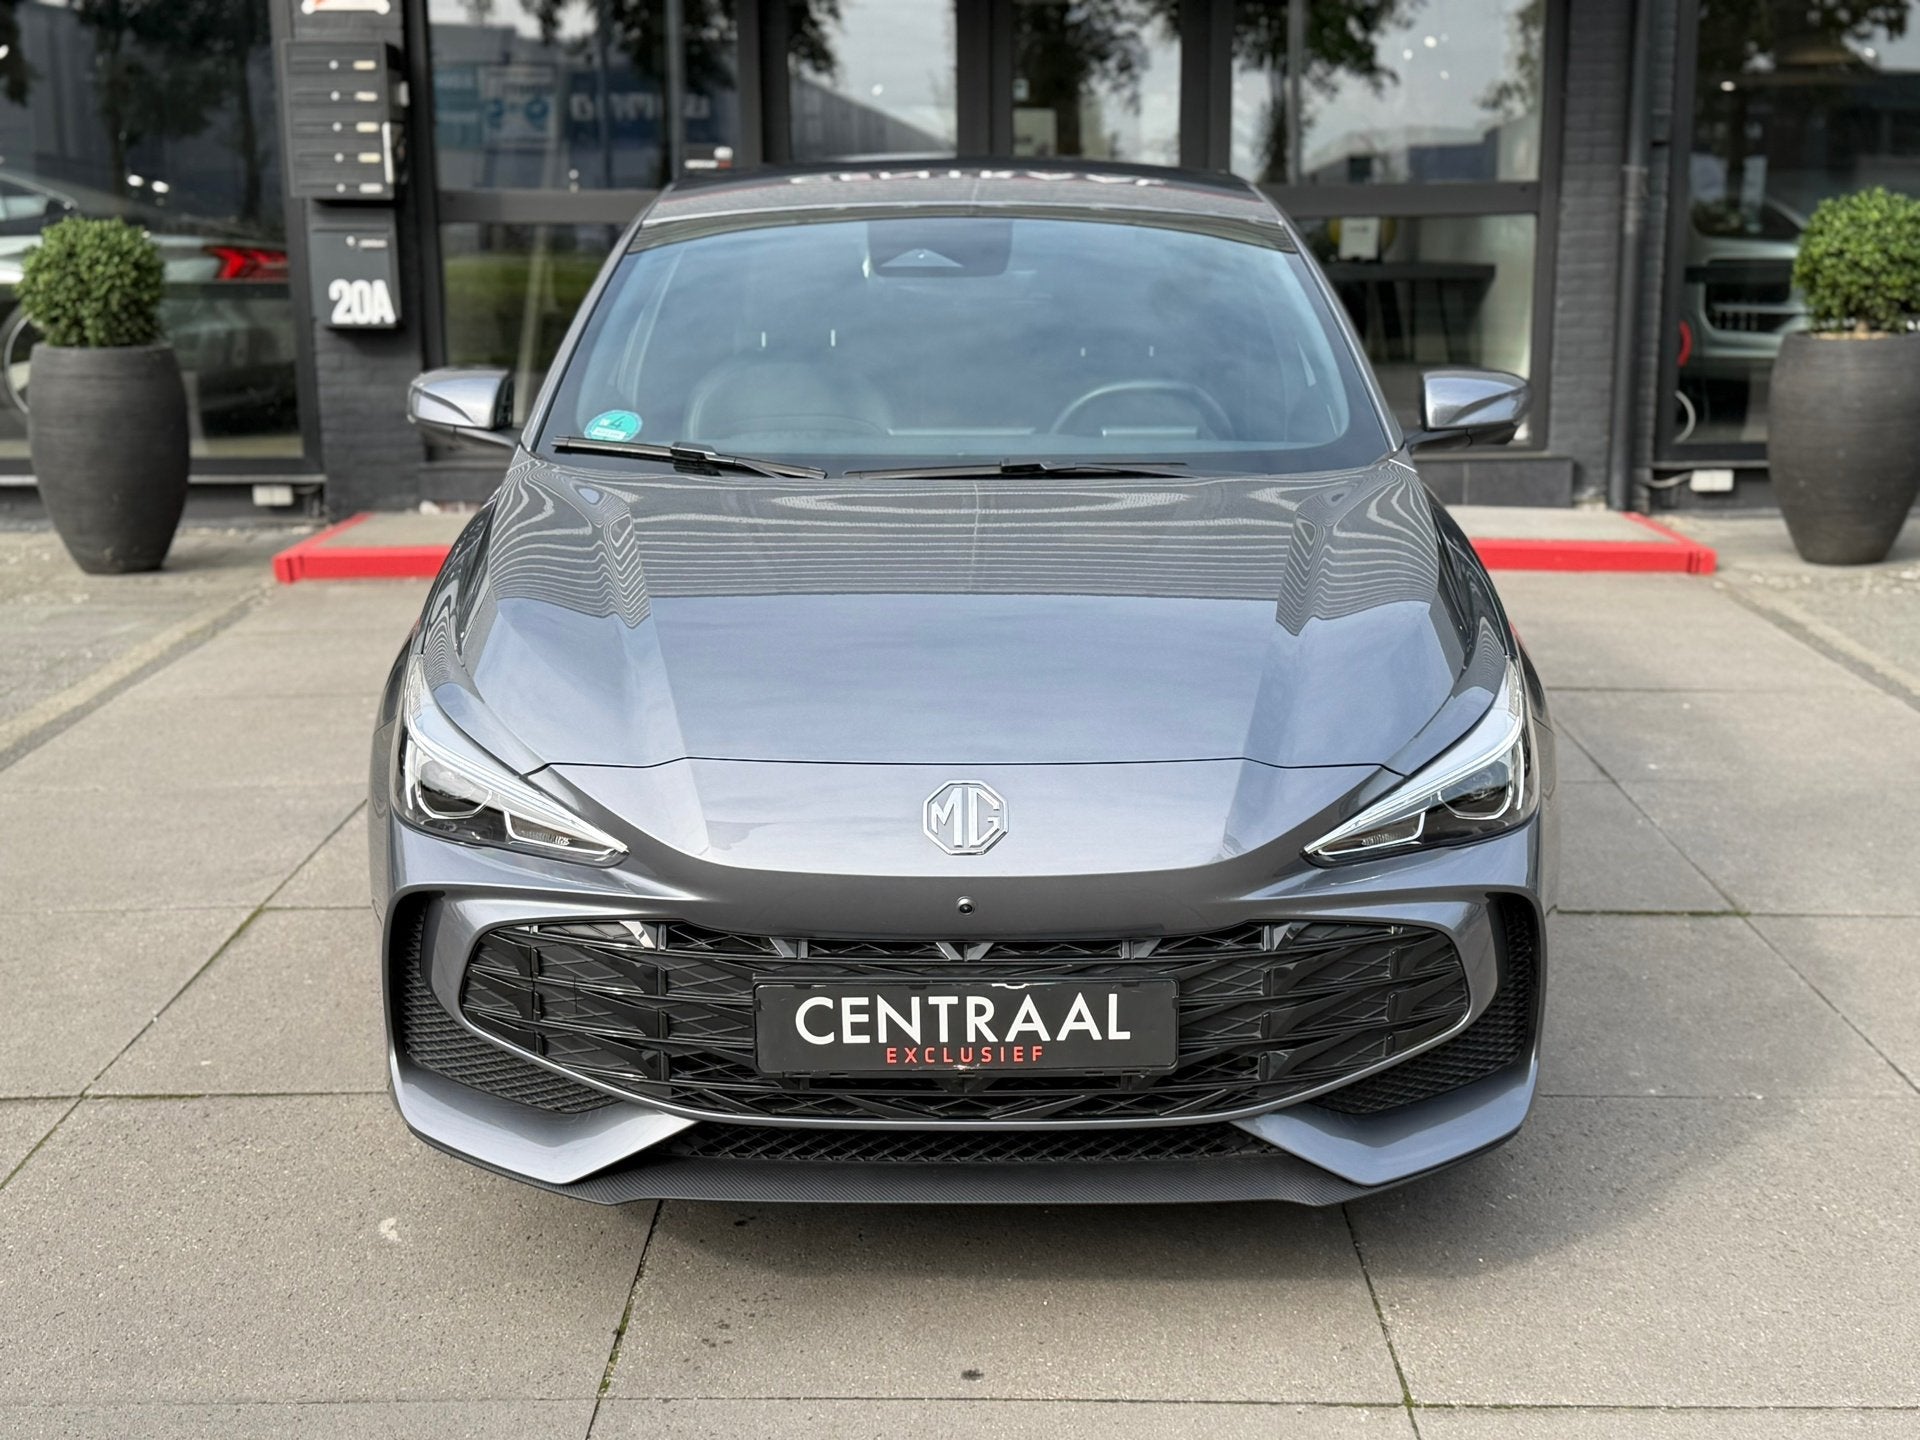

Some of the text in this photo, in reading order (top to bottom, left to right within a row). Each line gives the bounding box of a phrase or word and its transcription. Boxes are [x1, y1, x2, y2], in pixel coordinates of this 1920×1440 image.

[328, 278, 396, 324] 20A
[930, 786, 1001, 848] MG
[795, 992, 1131, 1045] CENTRAAL
[886, 1045, 1043, 1064] EXCLUSIEF
